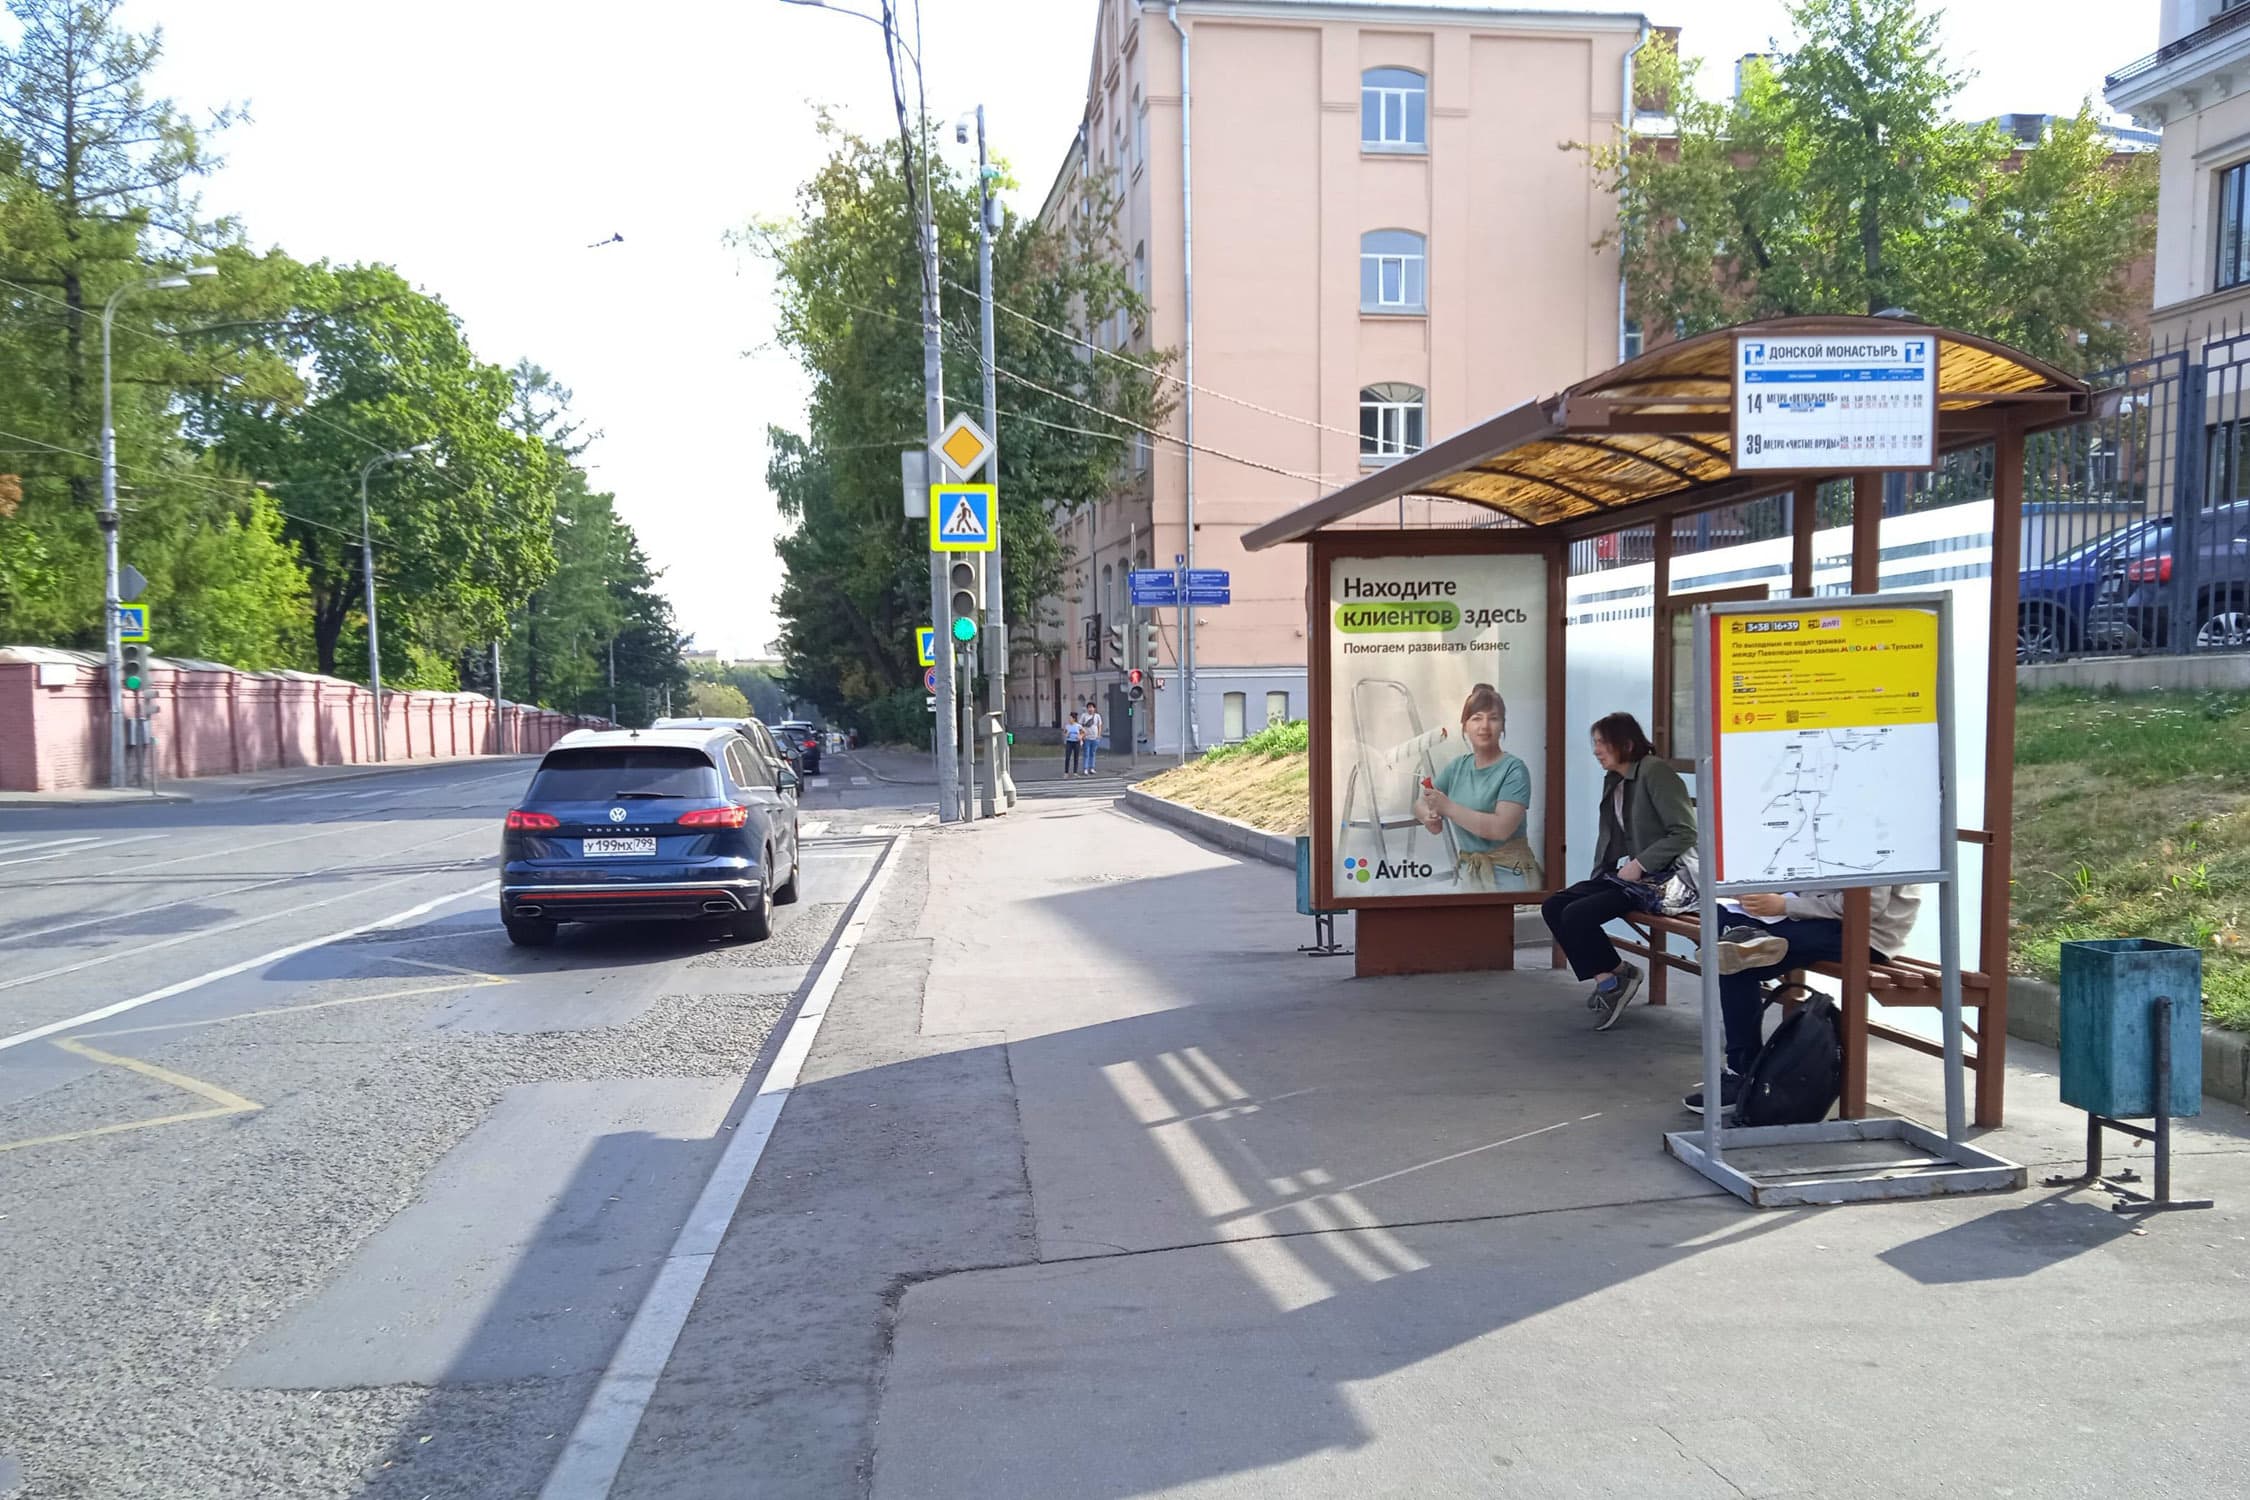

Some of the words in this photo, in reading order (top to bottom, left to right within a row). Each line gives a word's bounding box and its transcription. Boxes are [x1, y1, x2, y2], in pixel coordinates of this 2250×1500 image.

[1769, 344, 1823, 361] ДОНСКОЙ
[1826, 343, 1899, 359] МОНАСТЫРЬ
[1747, 393, 1763, 414] 14
[1746, 434, 1762, 455] 39
[1344, 577, 1457, 600] Находите
[1343, 609, 1453, 627] клиентов
[1464, 607, 1528, 628] здесь
[1343, 642, 1405, 654] Помогаем
[1408, 642, 1467, 654] развивать
[1470, 639, 1510, 652] бизнес
[635, 838, 653, 848] 799
[1375, 859, 1433, 879] Avito
